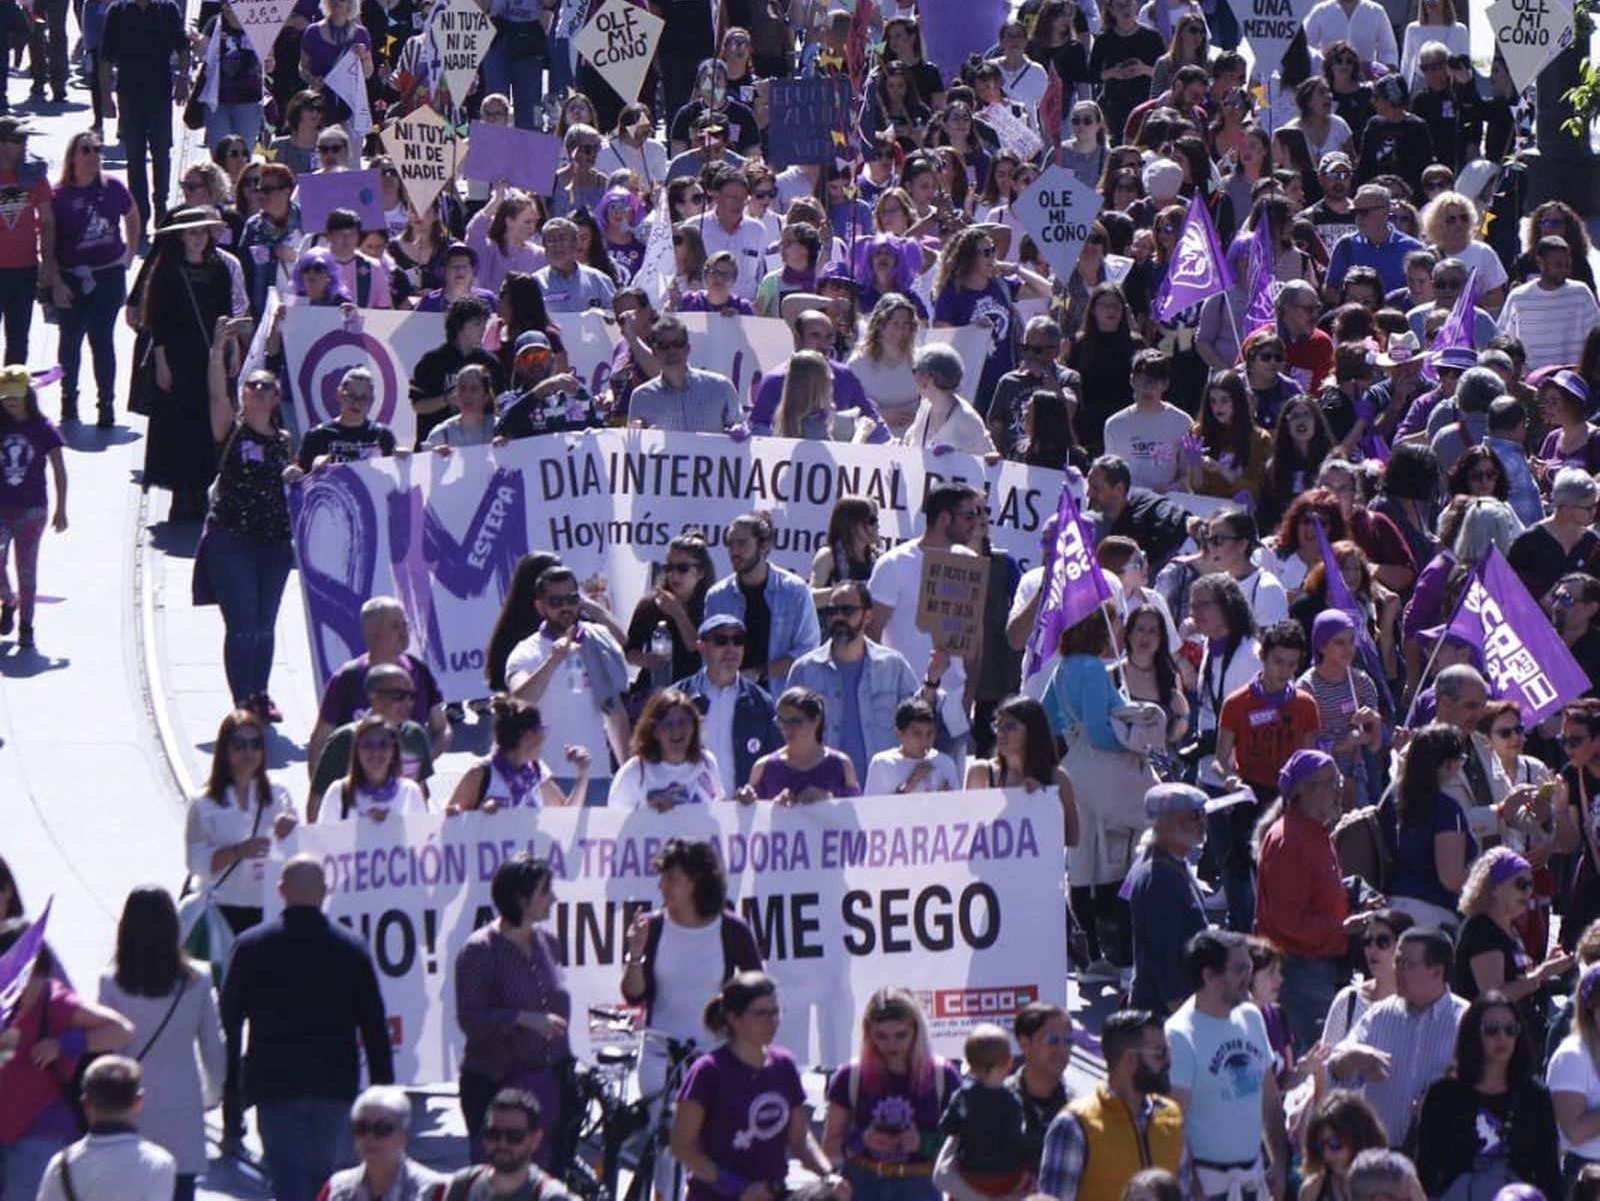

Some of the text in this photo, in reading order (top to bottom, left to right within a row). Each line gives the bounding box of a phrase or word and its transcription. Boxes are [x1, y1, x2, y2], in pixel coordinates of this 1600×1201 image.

[441, 11, 454, 30] NI
[457, 11, 489, 31] TUYA
[596, 7, 638, 33] OLE
[1243, 20, 1296, 39] MENOS
[1517, 12, 1541, 29] MI
[447, 33, 477, 50] NI DE
[608, 25, 635, 48] MI
[444, 53, 477, 71] NADIE
[394, 121, 413, 140] NI
[404, 143, 443, 163] NI DE
[401, 164, 446, 181] NADIE
[1039, 190, 1073, 208] OLE
[1049, 210, 1065, 224] MI
[1042, 221, 1087, 242] COÑO
[539, 444, 601, 501] DÍA
[608, 451, 906, 510] INTERNACIONAL
[467, 486, 517, 570] ESTEPA
[549, 515, 605, 554] Hoy
[608, 512, 669, 546] más
[322, 833, 467, 895] OTECCIÓN
[577, 830, 811, 878] TRABADORA
[821, 817, 1040, 869] EMBARAZADA
[841, 881, 1001, 957] SEGO
[943, 991, 1016, 1014] CCOO
